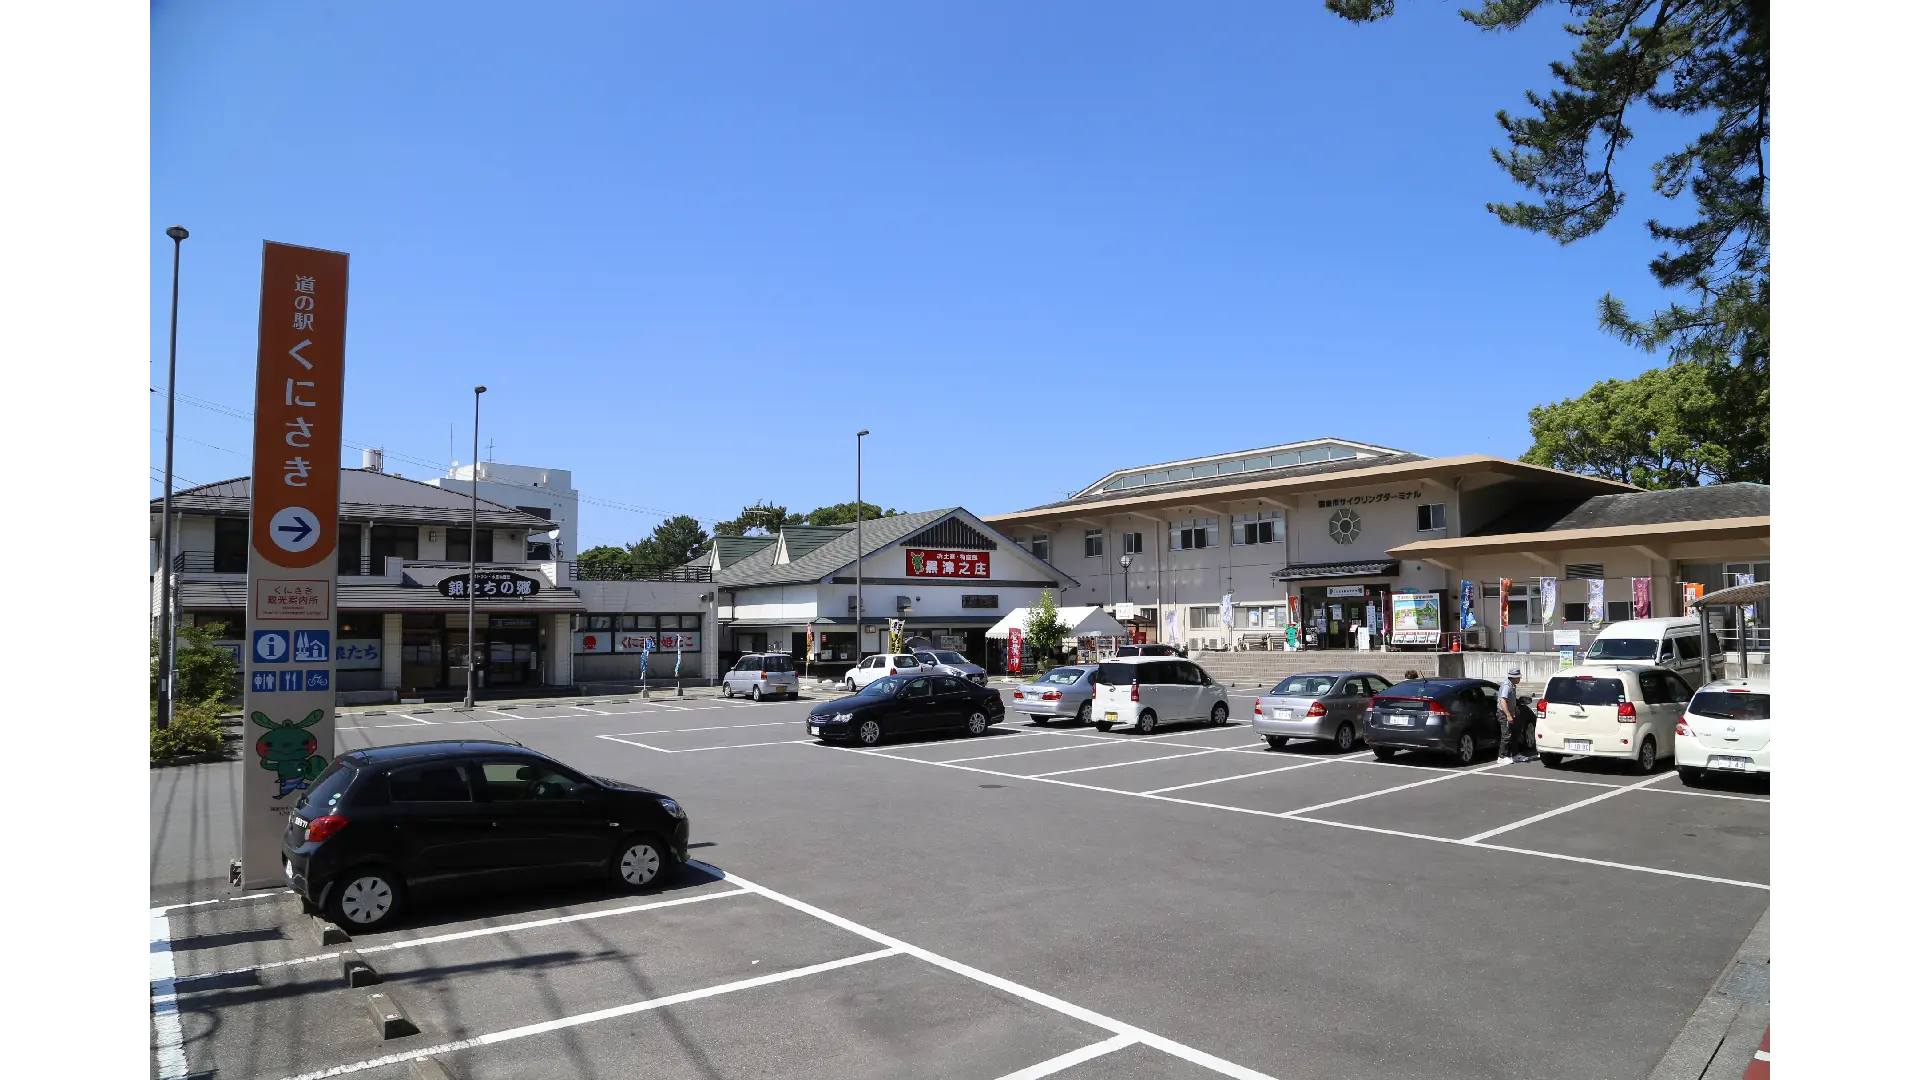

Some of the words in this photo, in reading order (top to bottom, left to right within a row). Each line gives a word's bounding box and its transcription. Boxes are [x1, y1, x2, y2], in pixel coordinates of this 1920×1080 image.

[293, 275, 316, 331] 道の駅
[283, 338, 316, 487] くにさき
[267, 595, 319, 605] 観光案内所
[274, 585, 313, 595] くにさき
